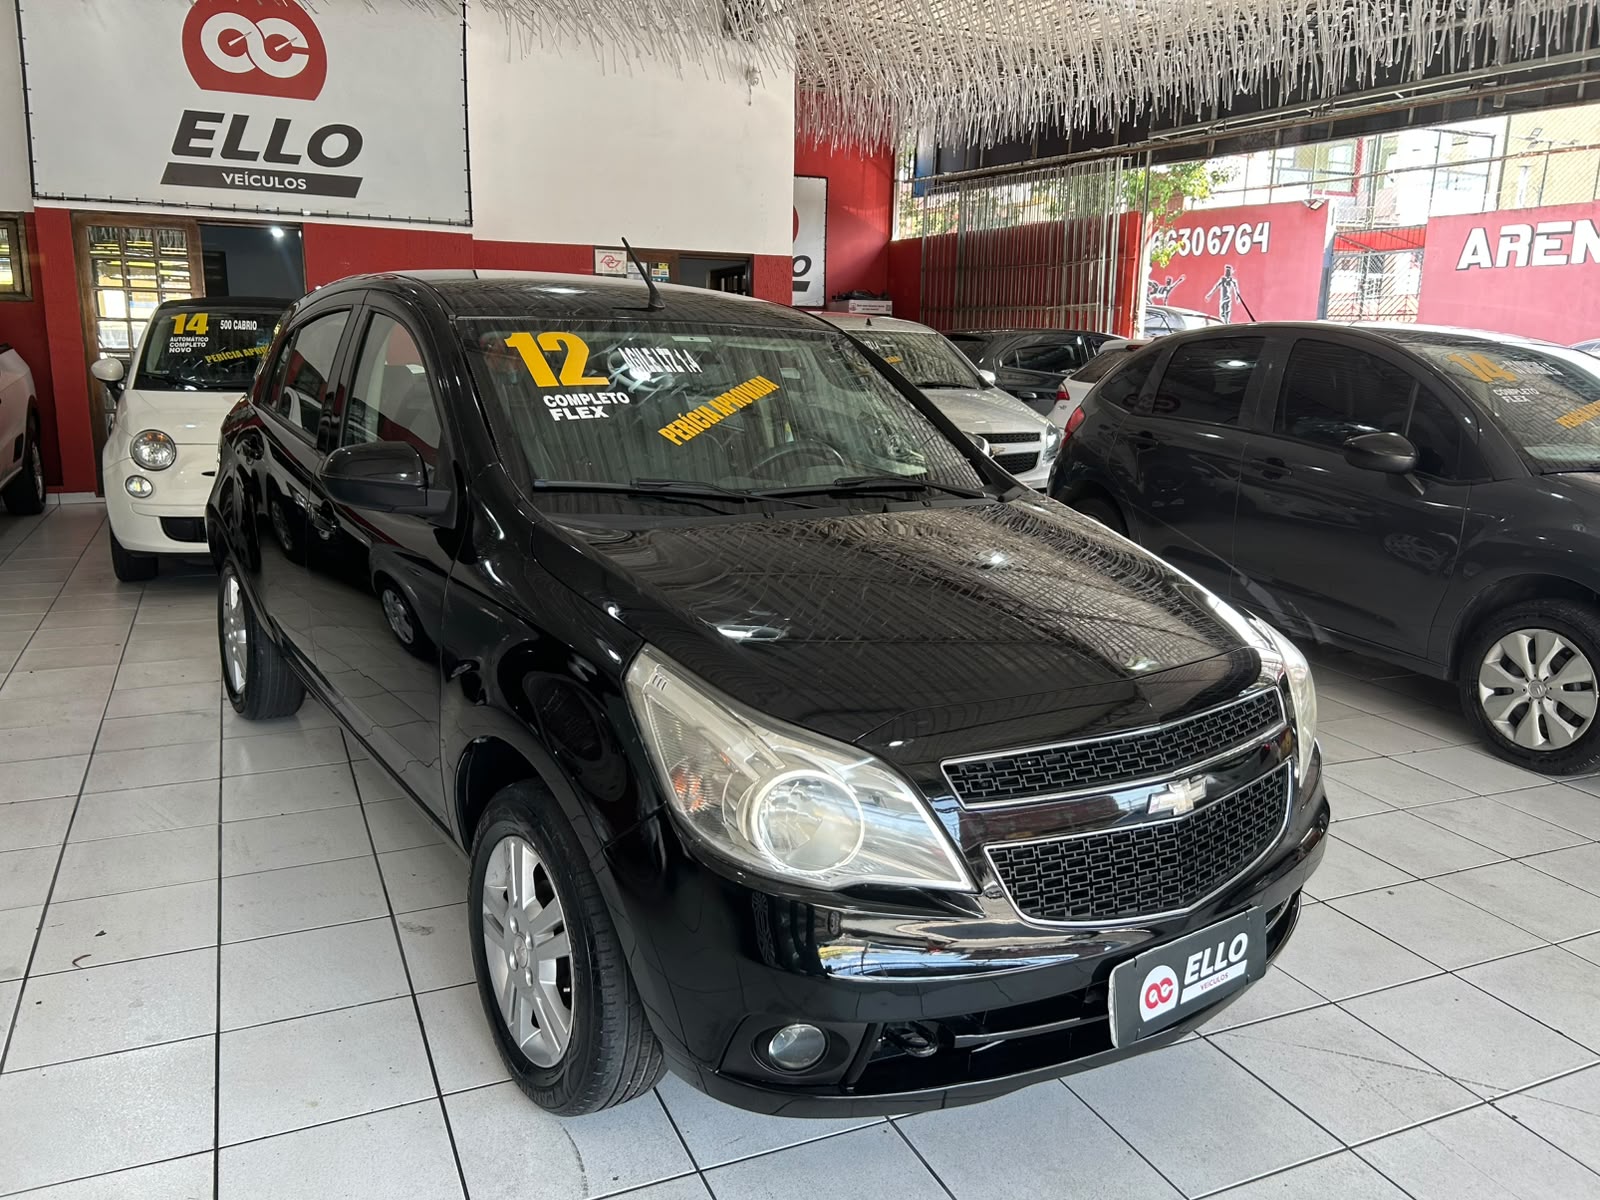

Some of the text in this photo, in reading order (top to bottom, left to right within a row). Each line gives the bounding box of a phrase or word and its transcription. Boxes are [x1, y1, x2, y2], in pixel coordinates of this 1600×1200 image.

[171, 110, 364, 168] ELLO
[222, 171, 307, 190] VEÍCULOS
[171, 313, 209, 335] 14
[220, 320, 257, 330] 500 CABRIO
[205, 349, 244, 363] PERÍCIA
[504, 331, 610, 388] 12
[617, 346, 664, 373] AGILE
[650, 347, 686, 373] LTZ
[1447, 353, 1517, 384] 14
[543, 392, 630, 408] COMPLETO
[658, 375, 780, 446] PERÍCIA APROVADA
[549, 406, 609, 422] FLEX
[1184, 932, 1249, 986] ELLO
